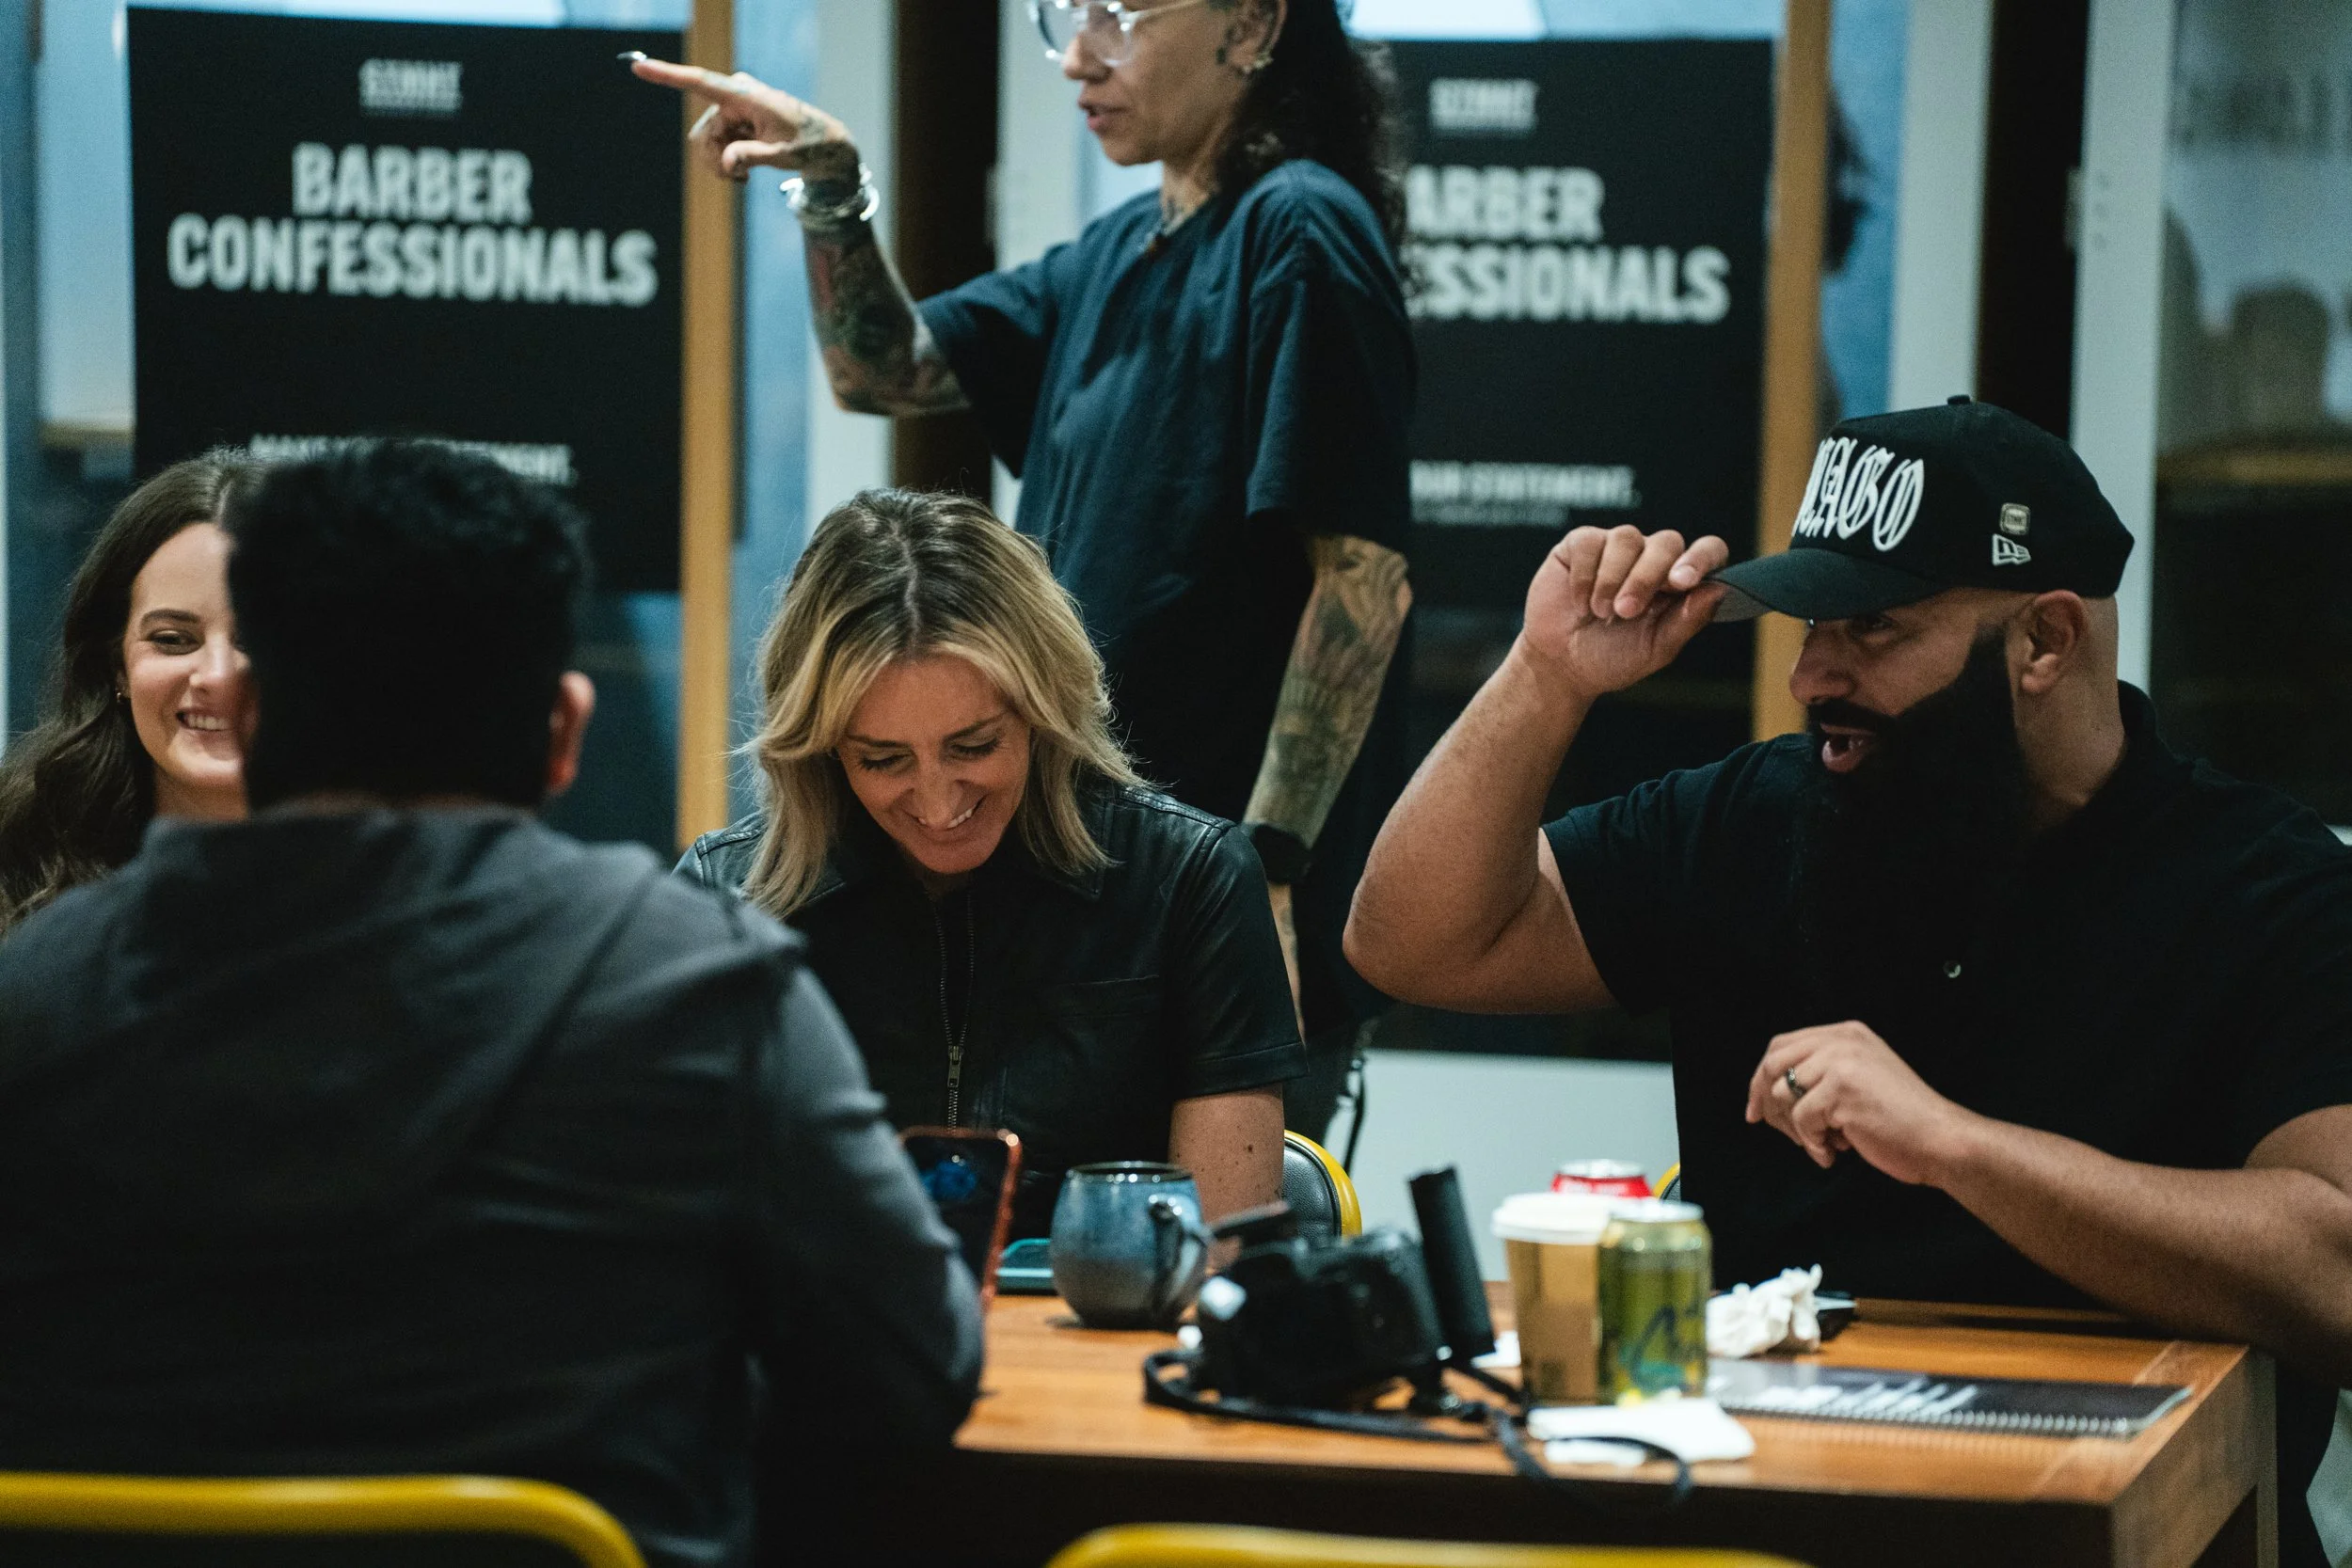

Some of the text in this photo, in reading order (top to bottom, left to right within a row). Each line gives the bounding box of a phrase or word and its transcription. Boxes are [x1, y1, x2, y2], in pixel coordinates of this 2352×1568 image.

[292, 142, 532, 223] BARBER
[1406, 164, 1605, 242] ARBER
[167, 213, 658, 307] CONFESSIONALS
